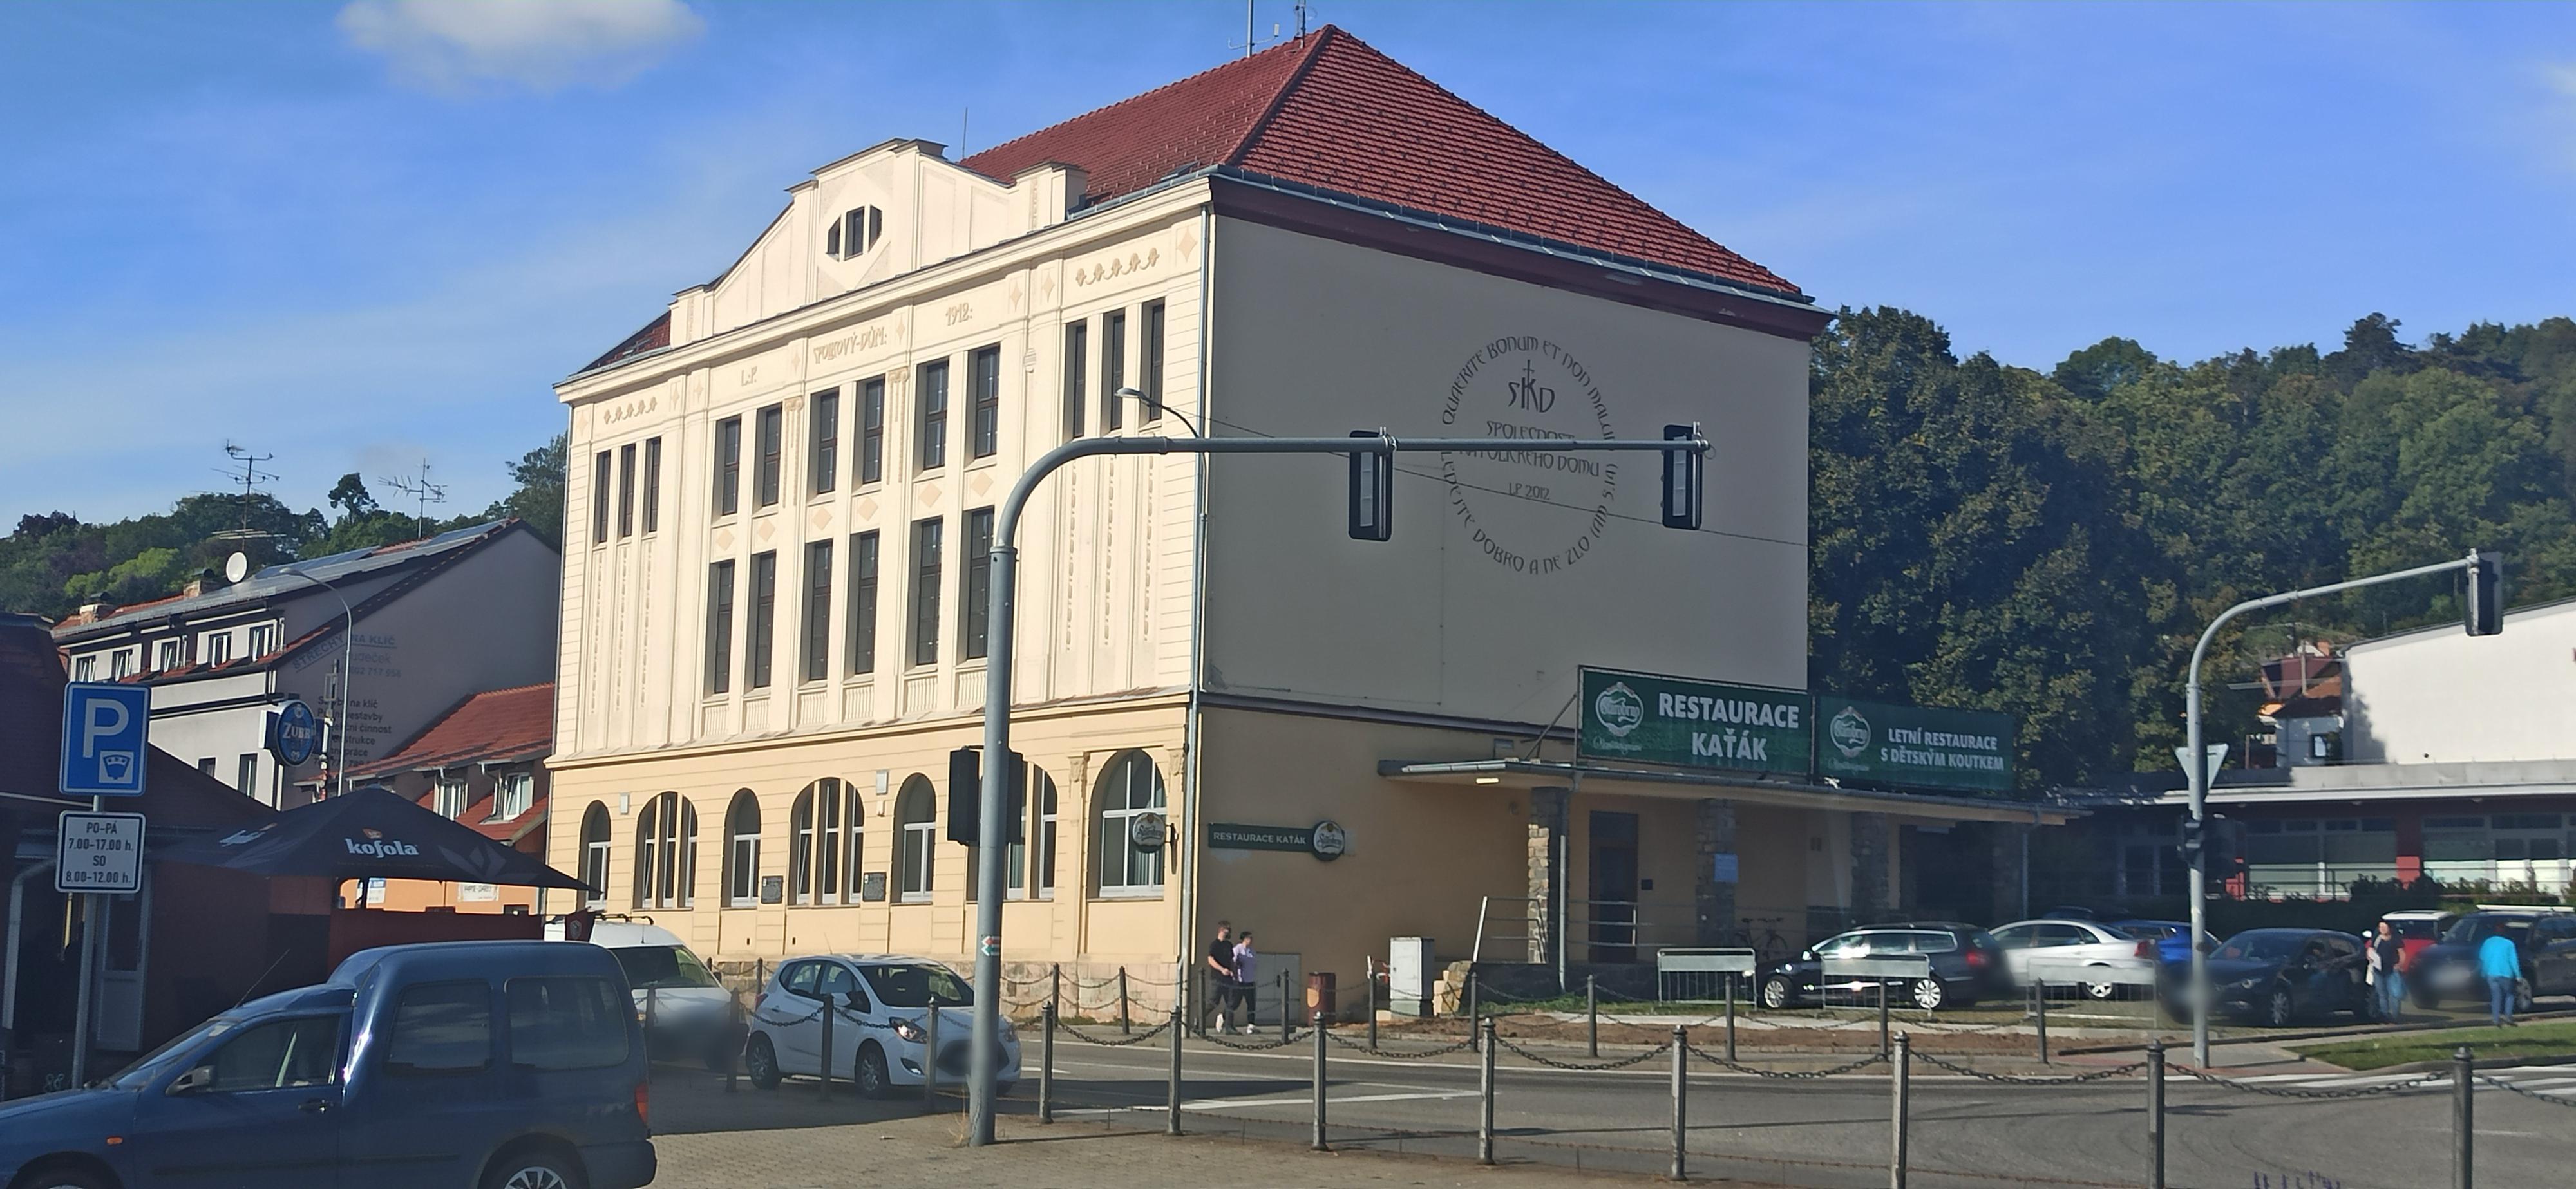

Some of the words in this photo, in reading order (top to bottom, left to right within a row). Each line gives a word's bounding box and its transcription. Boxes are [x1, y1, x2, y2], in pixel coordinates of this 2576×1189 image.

[1442, 350, 1487, 426] QUAERITE
[1486, 336, 1539, 360] BONUM
[1542, 341, 1562, 360] ET
[1562, 353, 1591, 388] NON
[1558, 455, 1600, 477] DOMU
[1526, 485, 1551, 500] 2012
[1441, 438, 1476, 529] LEDEJTE
[1473, 529, 1524, 572] DOBRO
[1530, 559, 1539, 575] A
[1543, 554, 1562, 574] NE
[1565, 536, 1591, 566] ZLO
[1658, 692, 1800, 729] RESTAURACE
[82, 698, 129, 758] P
[1888, 727, 1922, 745] LETNÍ
[1924, 731, 1998, 751] RESTAURACE
[1691, 727, 1768, 762] KAŤÁK
[1880, 747, 1888, 762] S
[1891, 745, 1946, 767] DĚTSKÝM
[1948, 753, 2005, 771] KOUTKEM
[86, 820, 118, 835] PO-PÁ
[1213, 831, 1274, 844] RESTAURACE
[1276, 834, 1307, 845] KAŤÁK
[68, 838, 122, 851] 7.00-17.00
[124, 839, 134, 852] h.
[345, 838, 419, 859] kofola
[93, 855, 106, 866] SO
[66, 870, 118, 883] 8.00-12.00
[122, 872, 131, 884] h.
